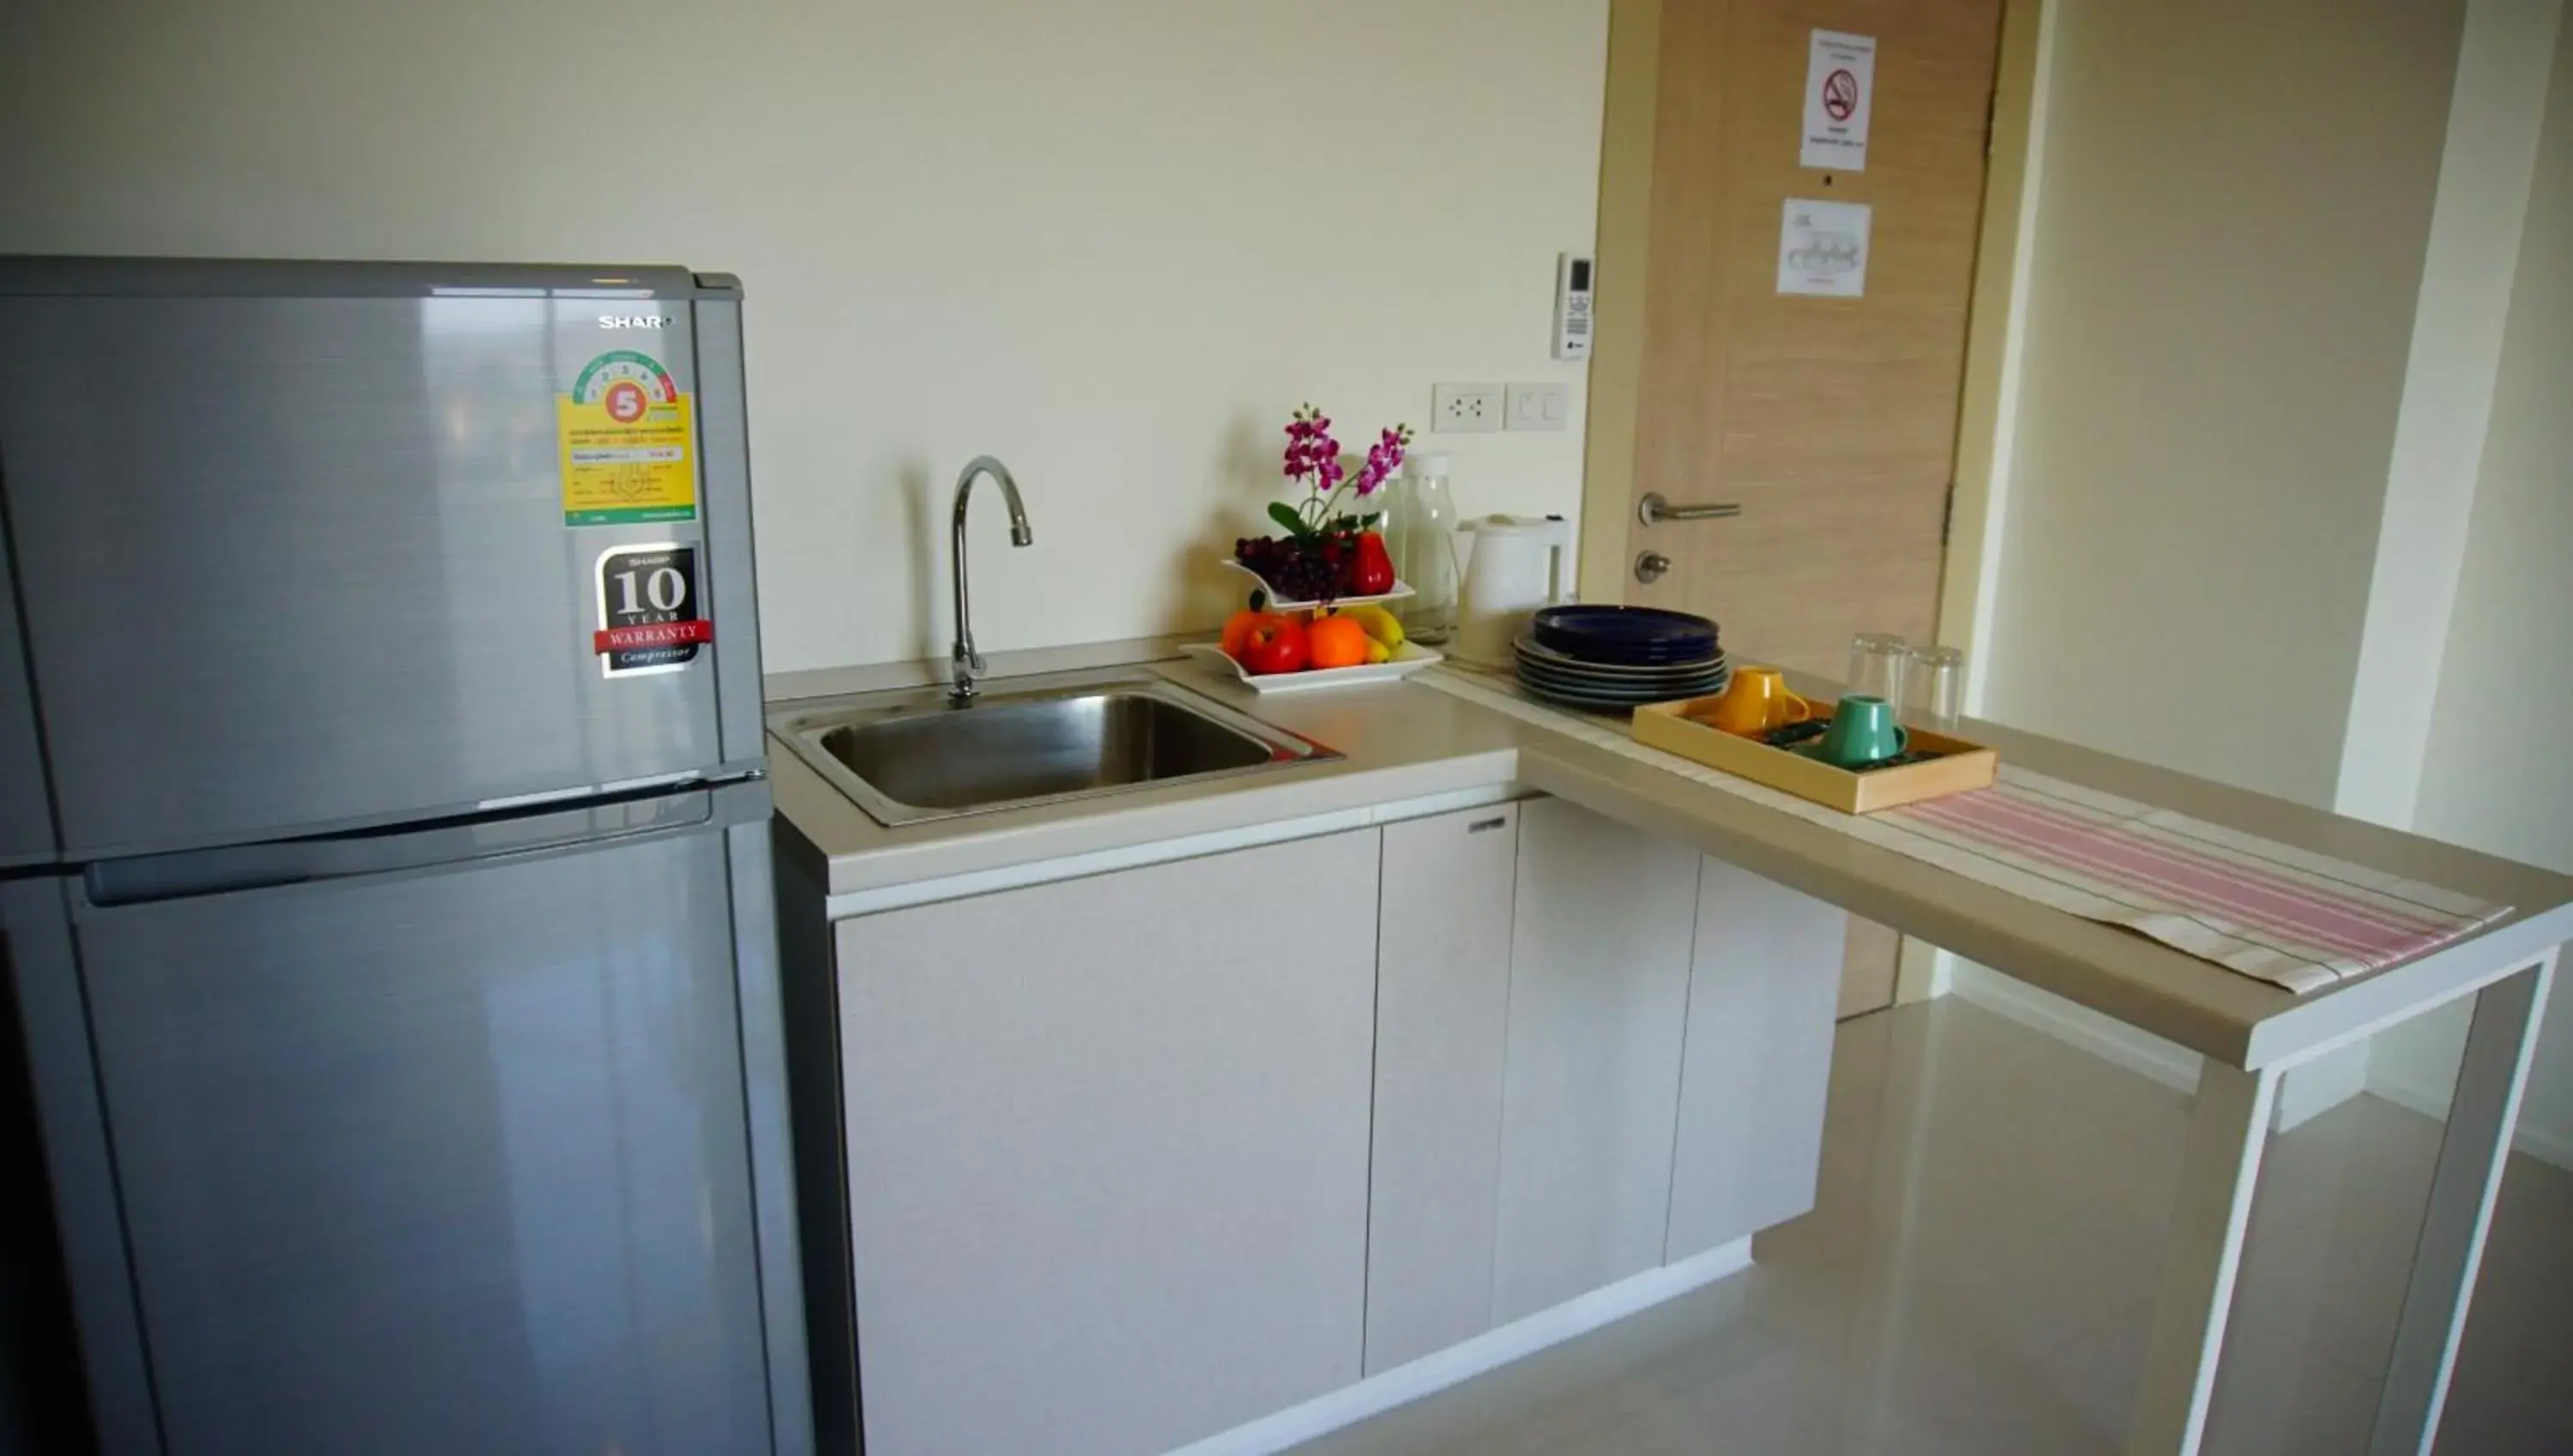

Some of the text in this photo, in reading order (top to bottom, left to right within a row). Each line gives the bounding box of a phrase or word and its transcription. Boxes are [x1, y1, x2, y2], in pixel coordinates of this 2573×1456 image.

[616, 389, 638, 418] 5
[628, 555, 671, 567] SHARP
[614, 567, 686, 614] 10
[628, 611, 679, 625] YEAR
[610, 625, 696, 645] WARRANTY
[621, 648, 690, 664] Compressor
